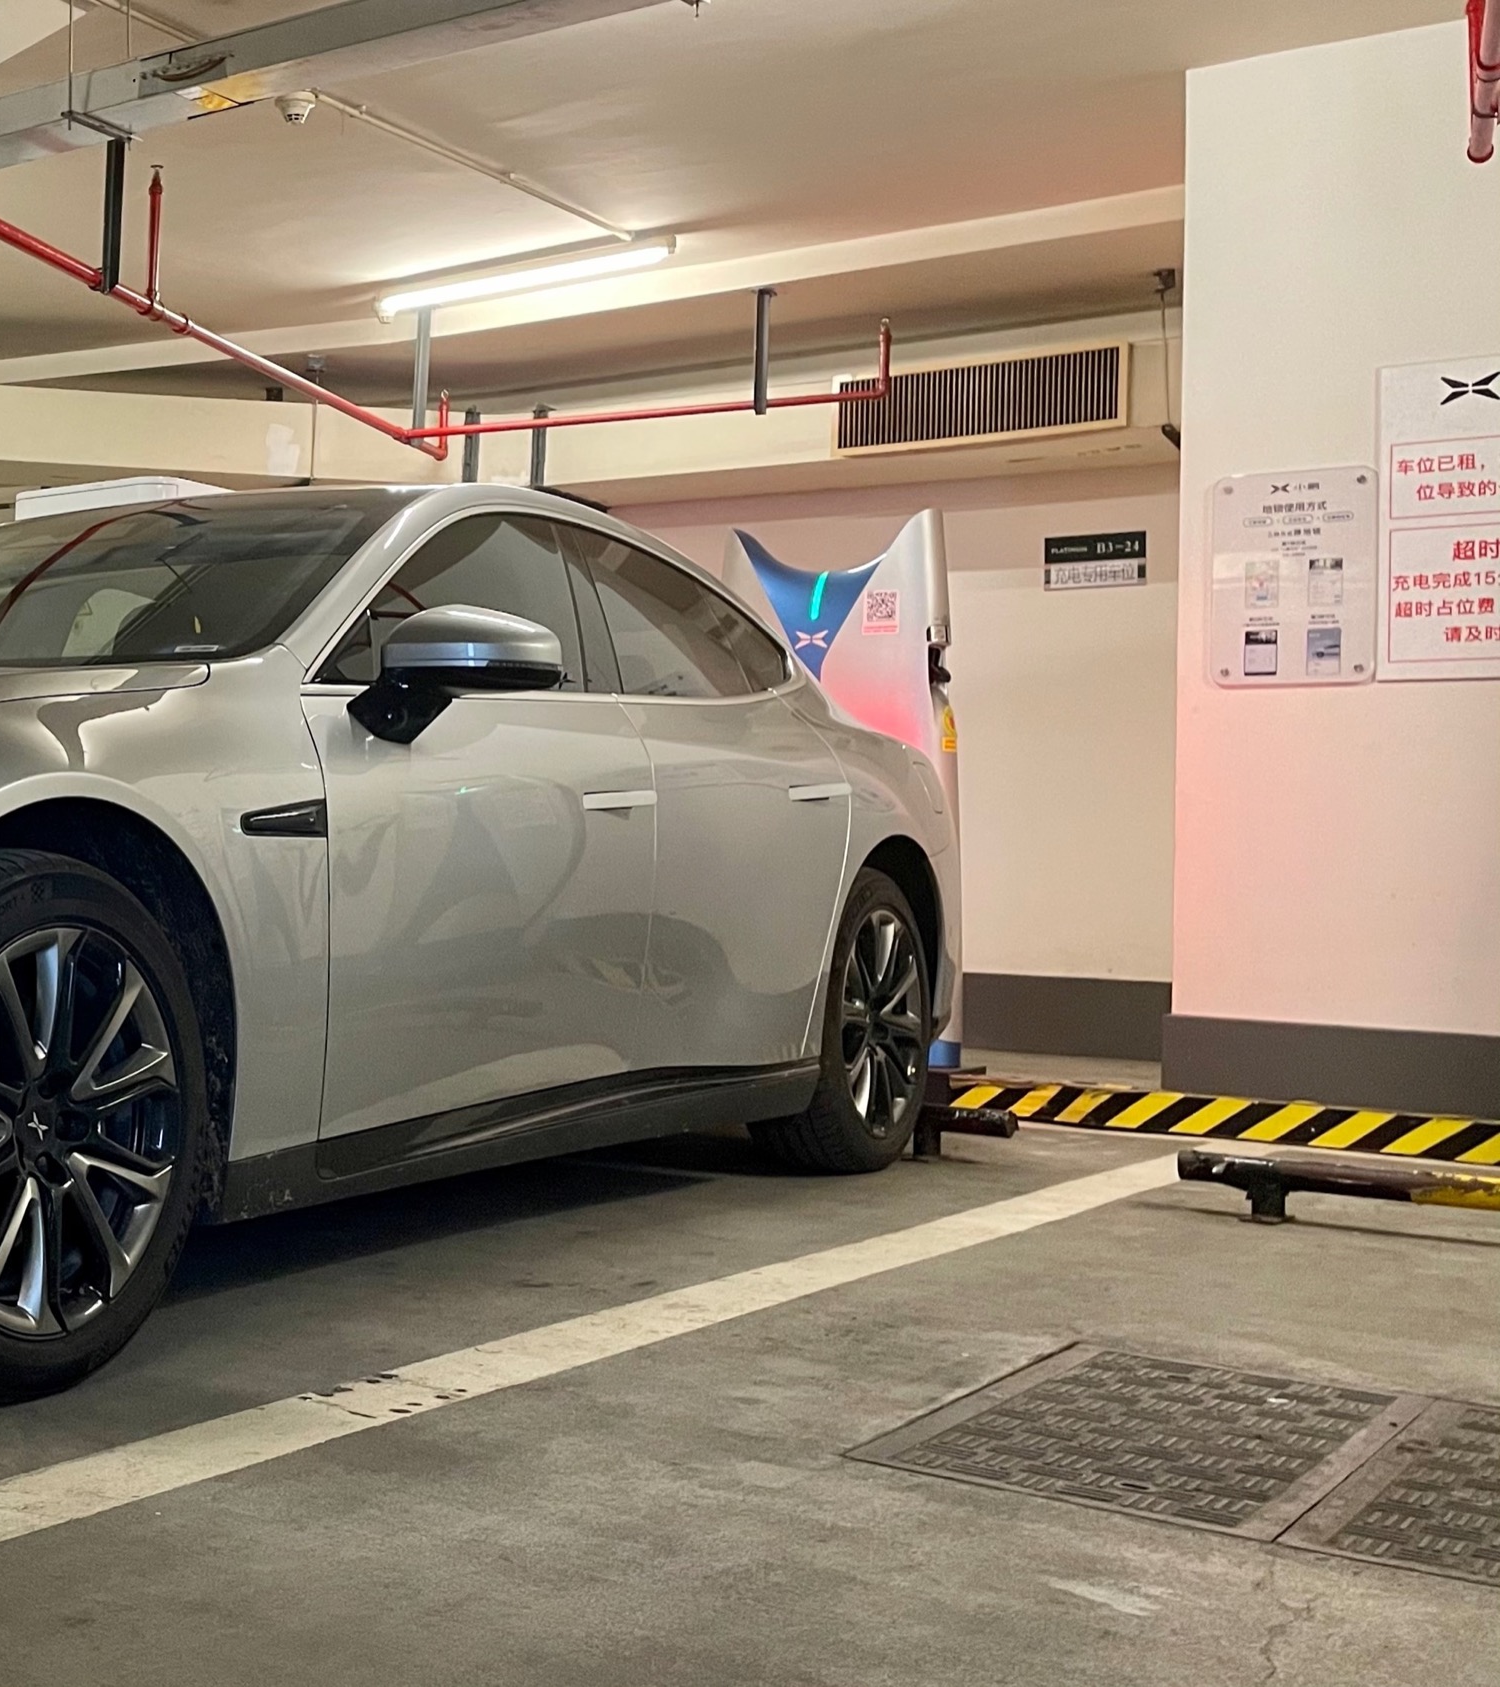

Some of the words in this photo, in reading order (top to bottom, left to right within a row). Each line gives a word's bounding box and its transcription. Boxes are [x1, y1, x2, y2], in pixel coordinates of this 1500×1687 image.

[1396, 453, 1485, 476] 车位已租，
[1416, 479, 1500, 501] 位导致的
[1096, 540, 1140, 554] B3-24
[1452, 538, 1500, 561] 超时
[1054, 563, 1136, 585] 充电专用车位
[1393, 571, 1500, 592] 充电完成15
[1395, 598, 1495, 618] 超时占位费
[1444, 625, 1500, 643] 请及时
